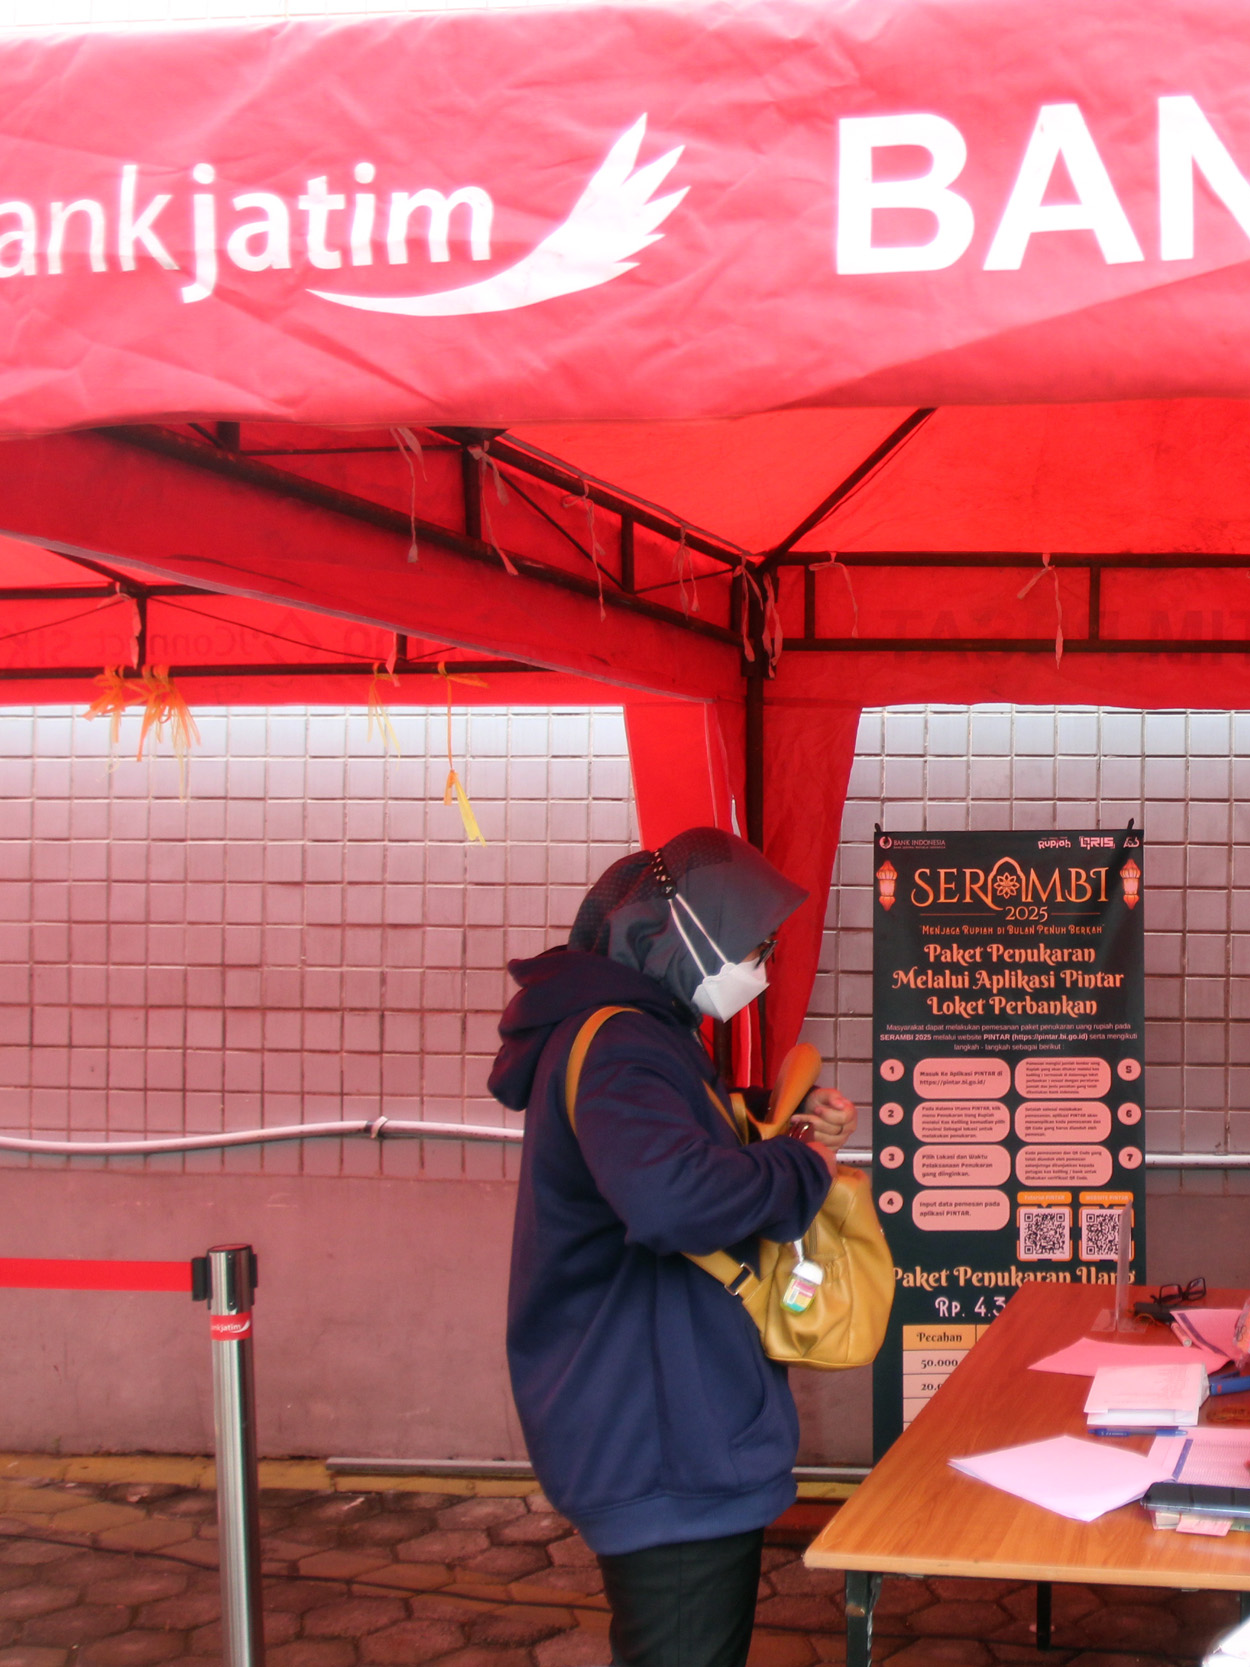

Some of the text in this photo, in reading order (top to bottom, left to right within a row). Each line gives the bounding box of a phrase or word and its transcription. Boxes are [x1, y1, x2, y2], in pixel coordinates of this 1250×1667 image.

[1080, 836, 1114, 850] QRIS
[911, 856, 1109, 911] SERAMBI
[1005, 905, 1049, 923] 2025
[924, 942, 1096, 966] Paket Penukaran
[891, 966, 1124, 993] Melalui Aplikasi Pintar
[927, 995, 1098, 1018] Loket Perbankan
[886, 1024, 925, 1032] Masyarakat
[925, 1024, 944, 1032] dapat
[1020, 1023, 1039, 1032] paket
[1039, 1023, 1075, 1032] penukaran
[1093, 1023, 1114, 1031] rupiah
[1114, 1023, 1131, 1031] pada
[880, 1033, 913, 1041] SERAMBI
[915, 1033, 932, 1041] 2025
[933, 1033, 956, 1041] melalui
[957, 1033, 982, 1041] website
[983, 1033, 1010, 1041] PINTAR
[1089, 1032, 1105, 1041] serta
[1107, 1032, 1138, 1041] mengikuti
[954, 1044, 980, 1052] langkah
[985, 1044, 1011, 1052] langkah
[1012, 1043, 1038, 1052] sebagai
[889, 1066, 895, 1075] 1
[1125, 1065, 1132, 1074] 5
[888, 1110, 895, 1118] 2
[1125, 1110, 1132, 1118] 6
[888, 1153, 895, 1162] 3
[1126, 1153, 1134, 1162] 7
[886, 1198, 895, 1206] 4
[953, 1265, 1071, 1288] Penukaran
[916, 1332, 963, 1343] Pecahan
[921, 1359, 958, 1369] 50.000
